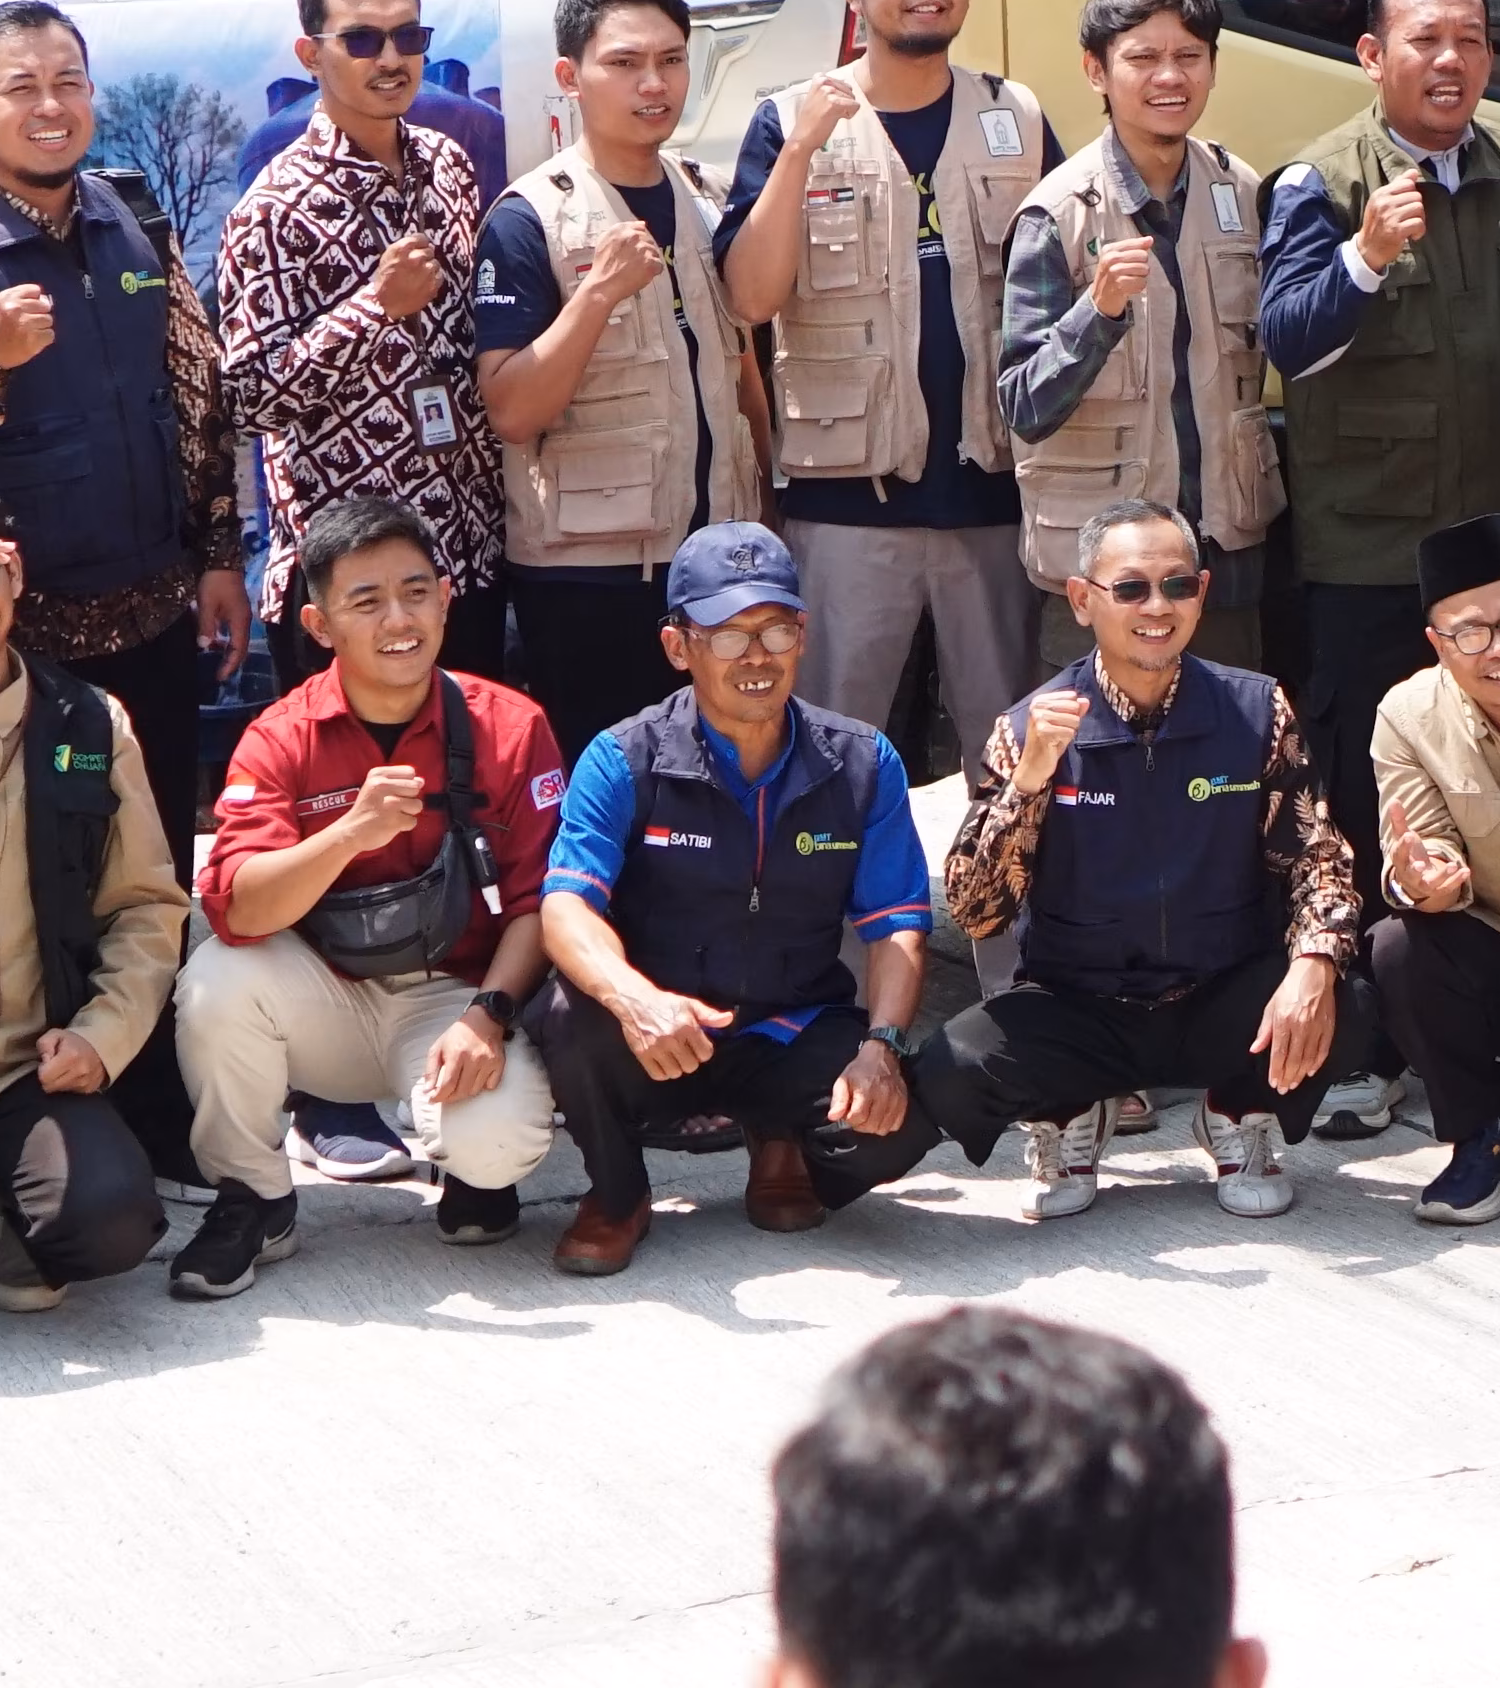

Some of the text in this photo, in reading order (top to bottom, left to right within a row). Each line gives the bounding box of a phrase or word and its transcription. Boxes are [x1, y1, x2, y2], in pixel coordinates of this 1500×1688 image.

[311, 794, 347, 811] RESCUE
[1077, 790, 1116, 806] FAJAR
[669, 831, 713, 849] SATIBI
